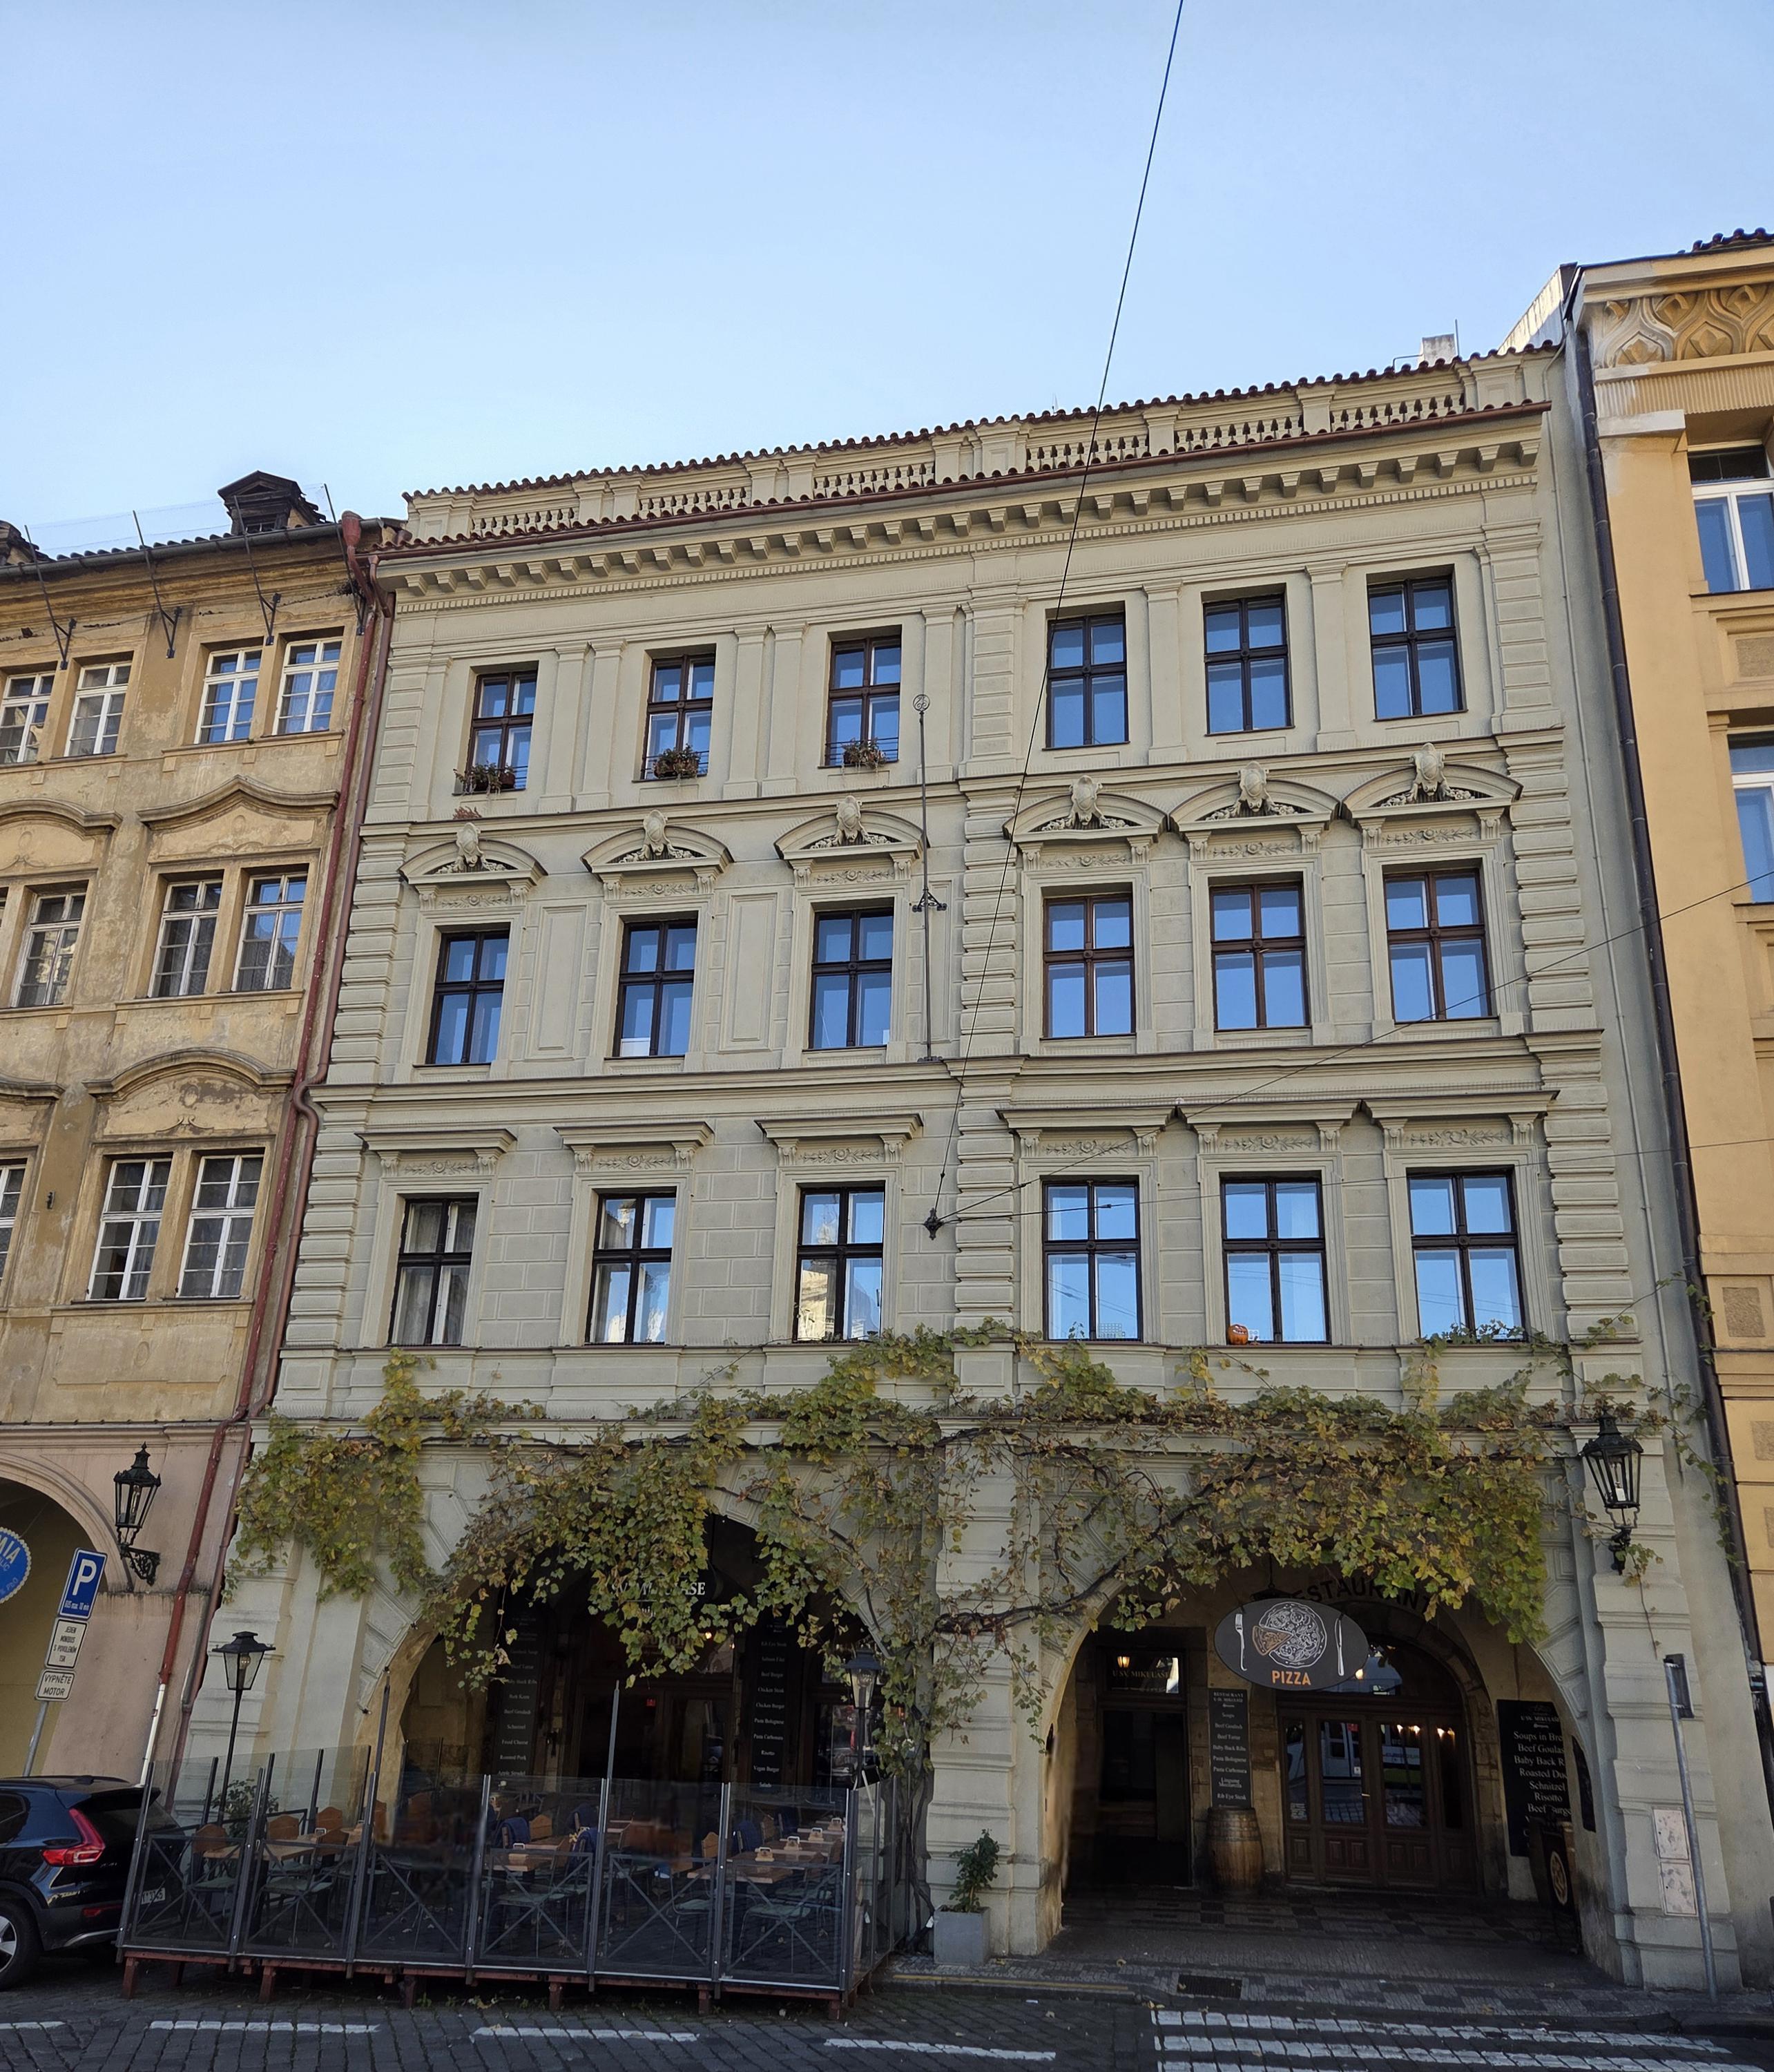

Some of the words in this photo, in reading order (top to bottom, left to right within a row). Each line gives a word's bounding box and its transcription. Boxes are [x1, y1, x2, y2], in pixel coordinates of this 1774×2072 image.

[73, 1559, 97, 1595] P
[1272, 1670, 1311, 1685] PIZZA
[43, 1687, 66, 1696] MOTOR
[1514, 1731, 1537, 1742] Soups
[1539, 1732, 1547, 1740] in
[1518, 1743, 1536, 1752] Beef
[1514, 1755, 1534, 1766] Baby
[1536, 1756, 1556, 1765] Back
[1519, 1767, 1550, 1778] Roasted
[1529, 1780, 1566, 1791] Schnitzel
[1534, 1792, 1563, 1802] Risotto
[1527, 1803, 1547, 1813] Beef
